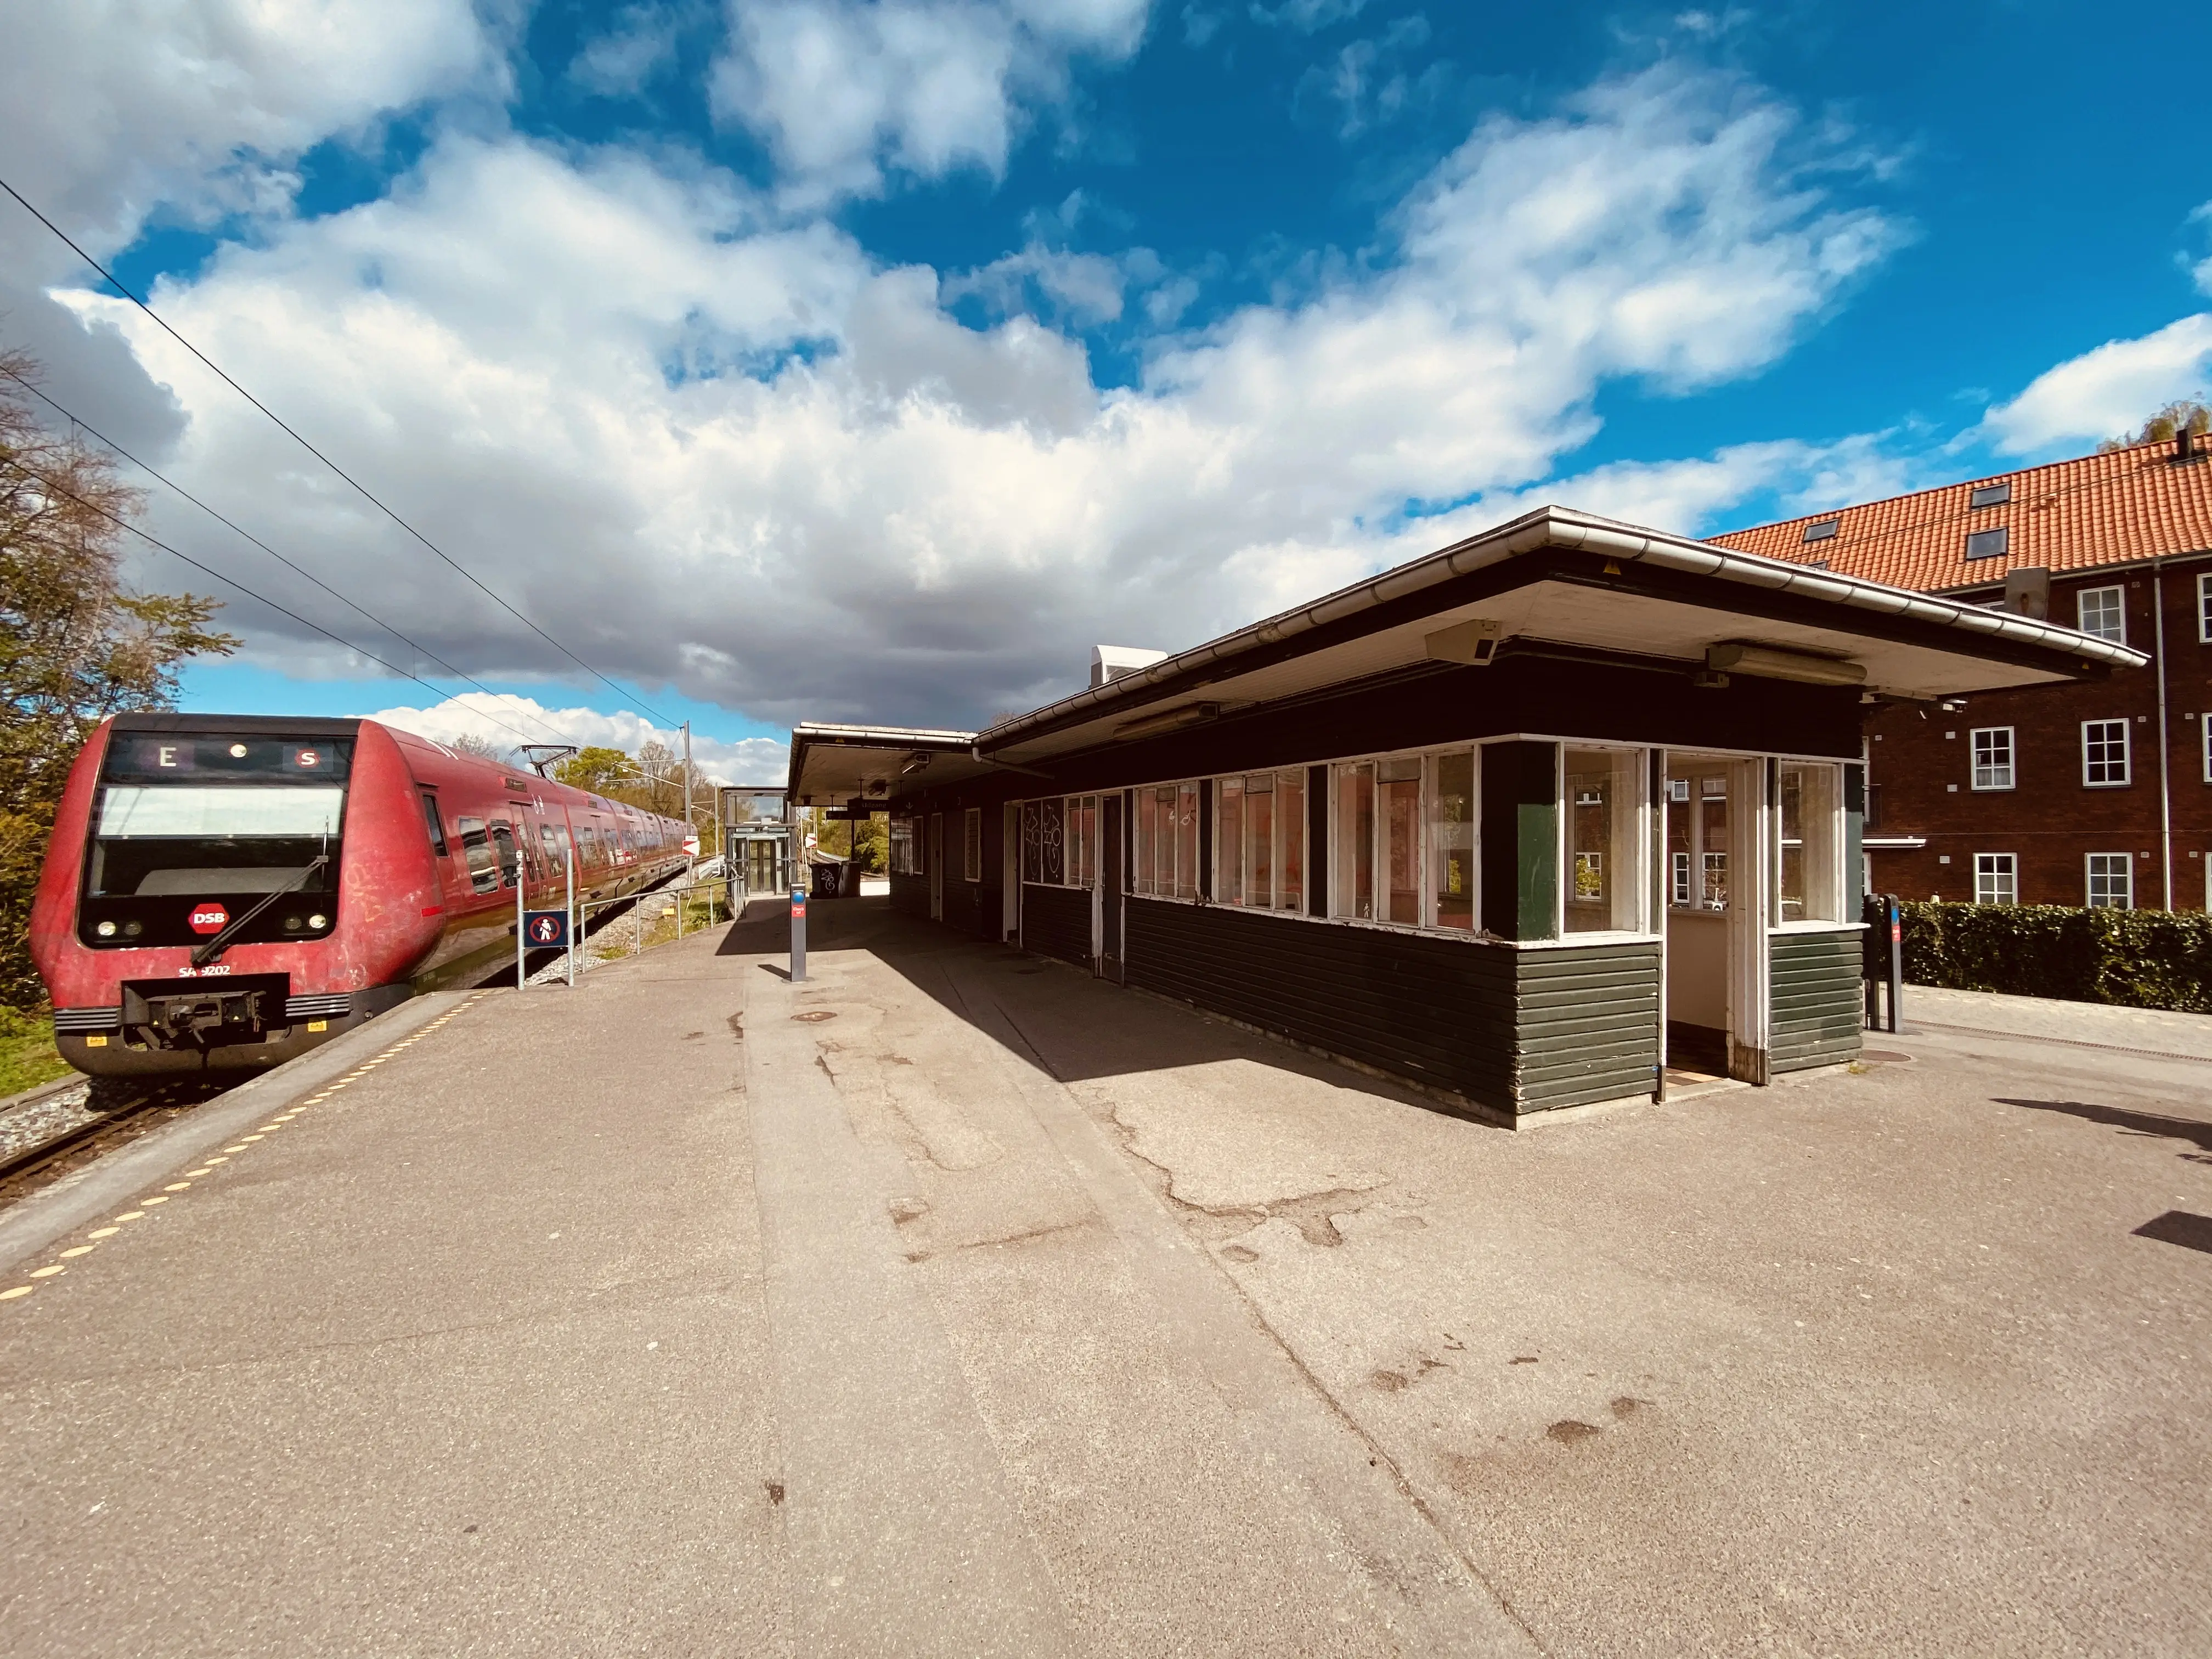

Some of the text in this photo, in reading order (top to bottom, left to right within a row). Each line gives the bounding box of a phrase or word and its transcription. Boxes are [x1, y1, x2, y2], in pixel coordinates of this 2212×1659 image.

[160, 747, 176, 767] E
[301, 752, 315, 765] S
[194, 912, 225, 924] DSB
[179, 967, 197, 977] SA
